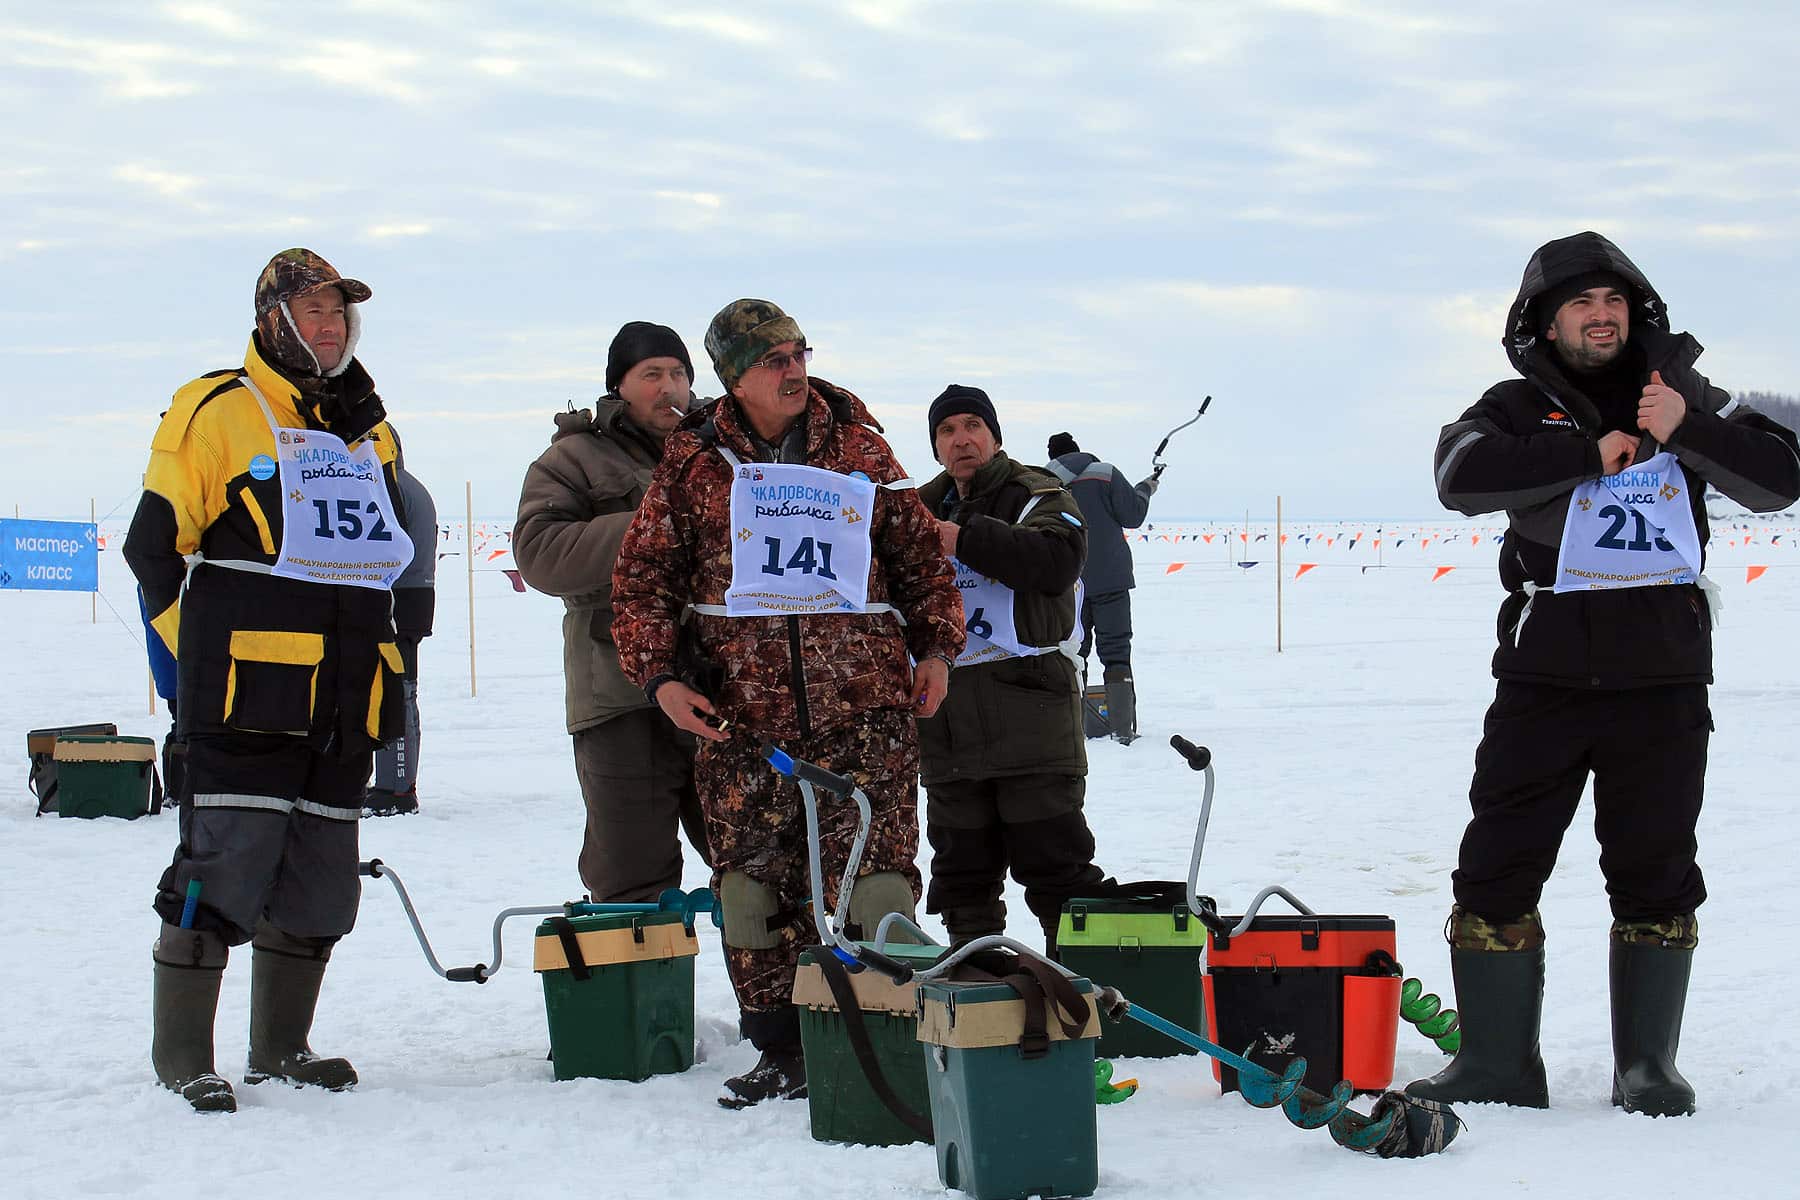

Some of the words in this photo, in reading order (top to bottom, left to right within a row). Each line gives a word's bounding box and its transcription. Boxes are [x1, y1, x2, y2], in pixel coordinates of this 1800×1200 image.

[294, 448, 374, 473] ЧКАЛОВАЯ
[752, 485, 840, 507] ЧКАЛОВСКАЯ
[312, 499, 392, 541] 152
[755, 501, 835, 521] рыбалка
[761, 535, 837, 581] 141
[27, 565, 73, 580] класс
[1565, 567, 1649, 582] МЕЖДУНАРОДНЫЙ
[397, 737, 405, 777] SIBE
